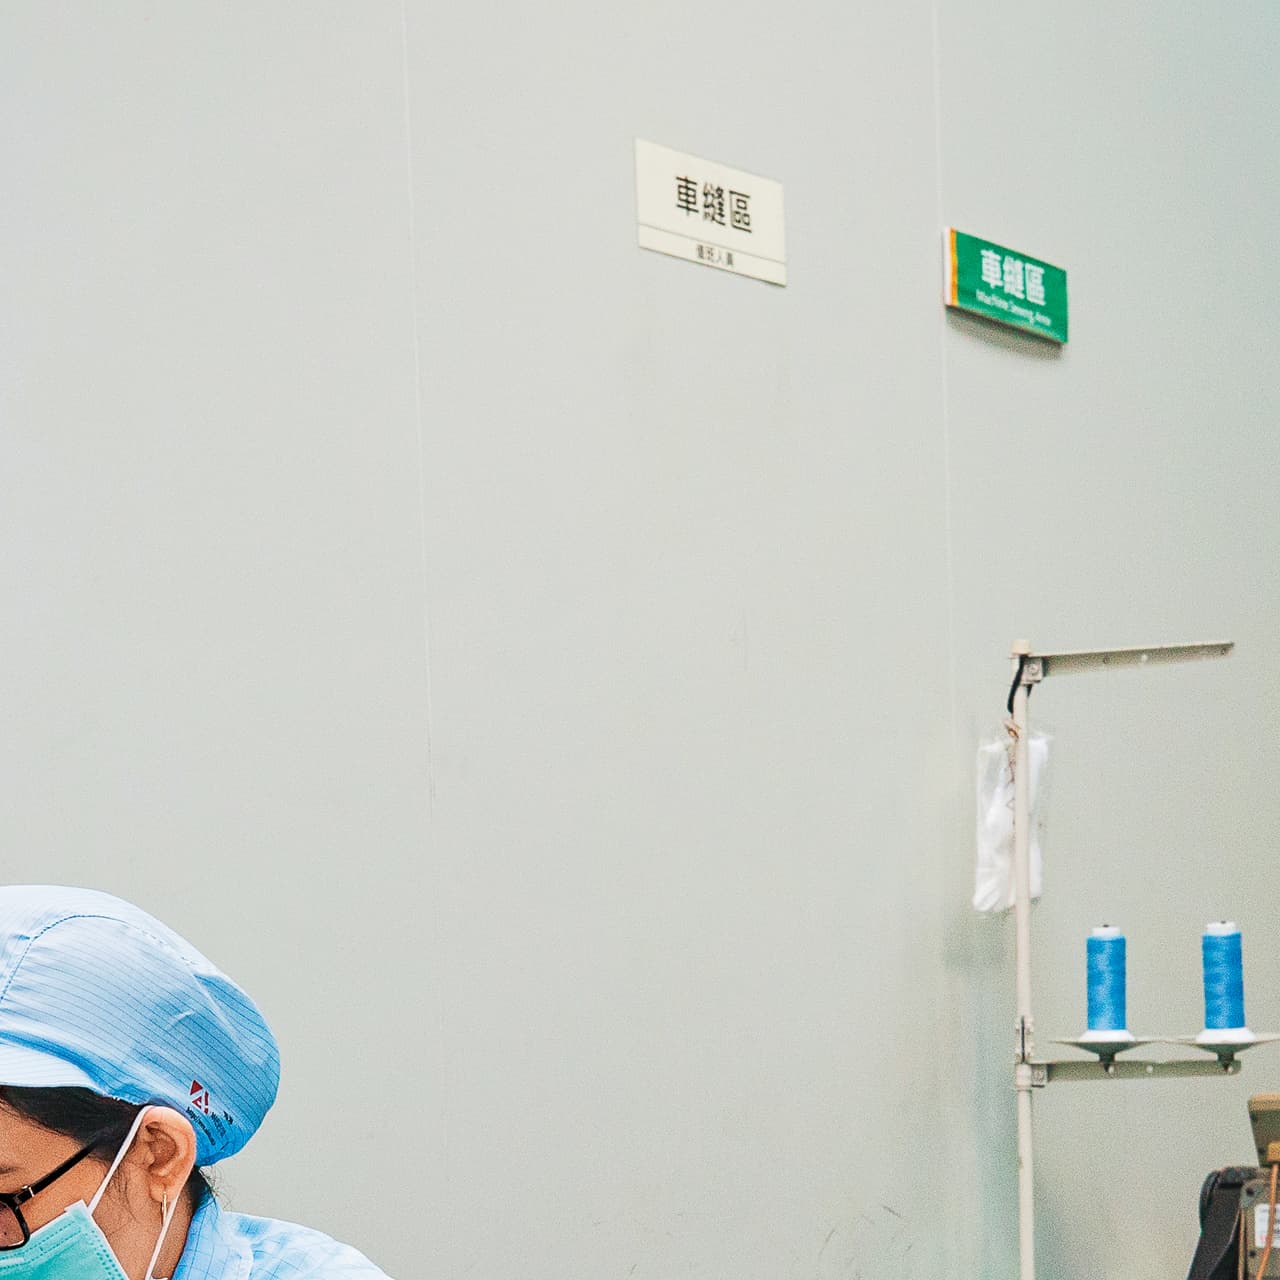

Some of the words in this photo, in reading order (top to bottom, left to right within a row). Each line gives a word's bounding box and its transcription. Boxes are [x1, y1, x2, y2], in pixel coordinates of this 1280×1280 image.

[675, 175, 753, 233] 車縫區
[980, 249, 1046, 306] 車縫區
